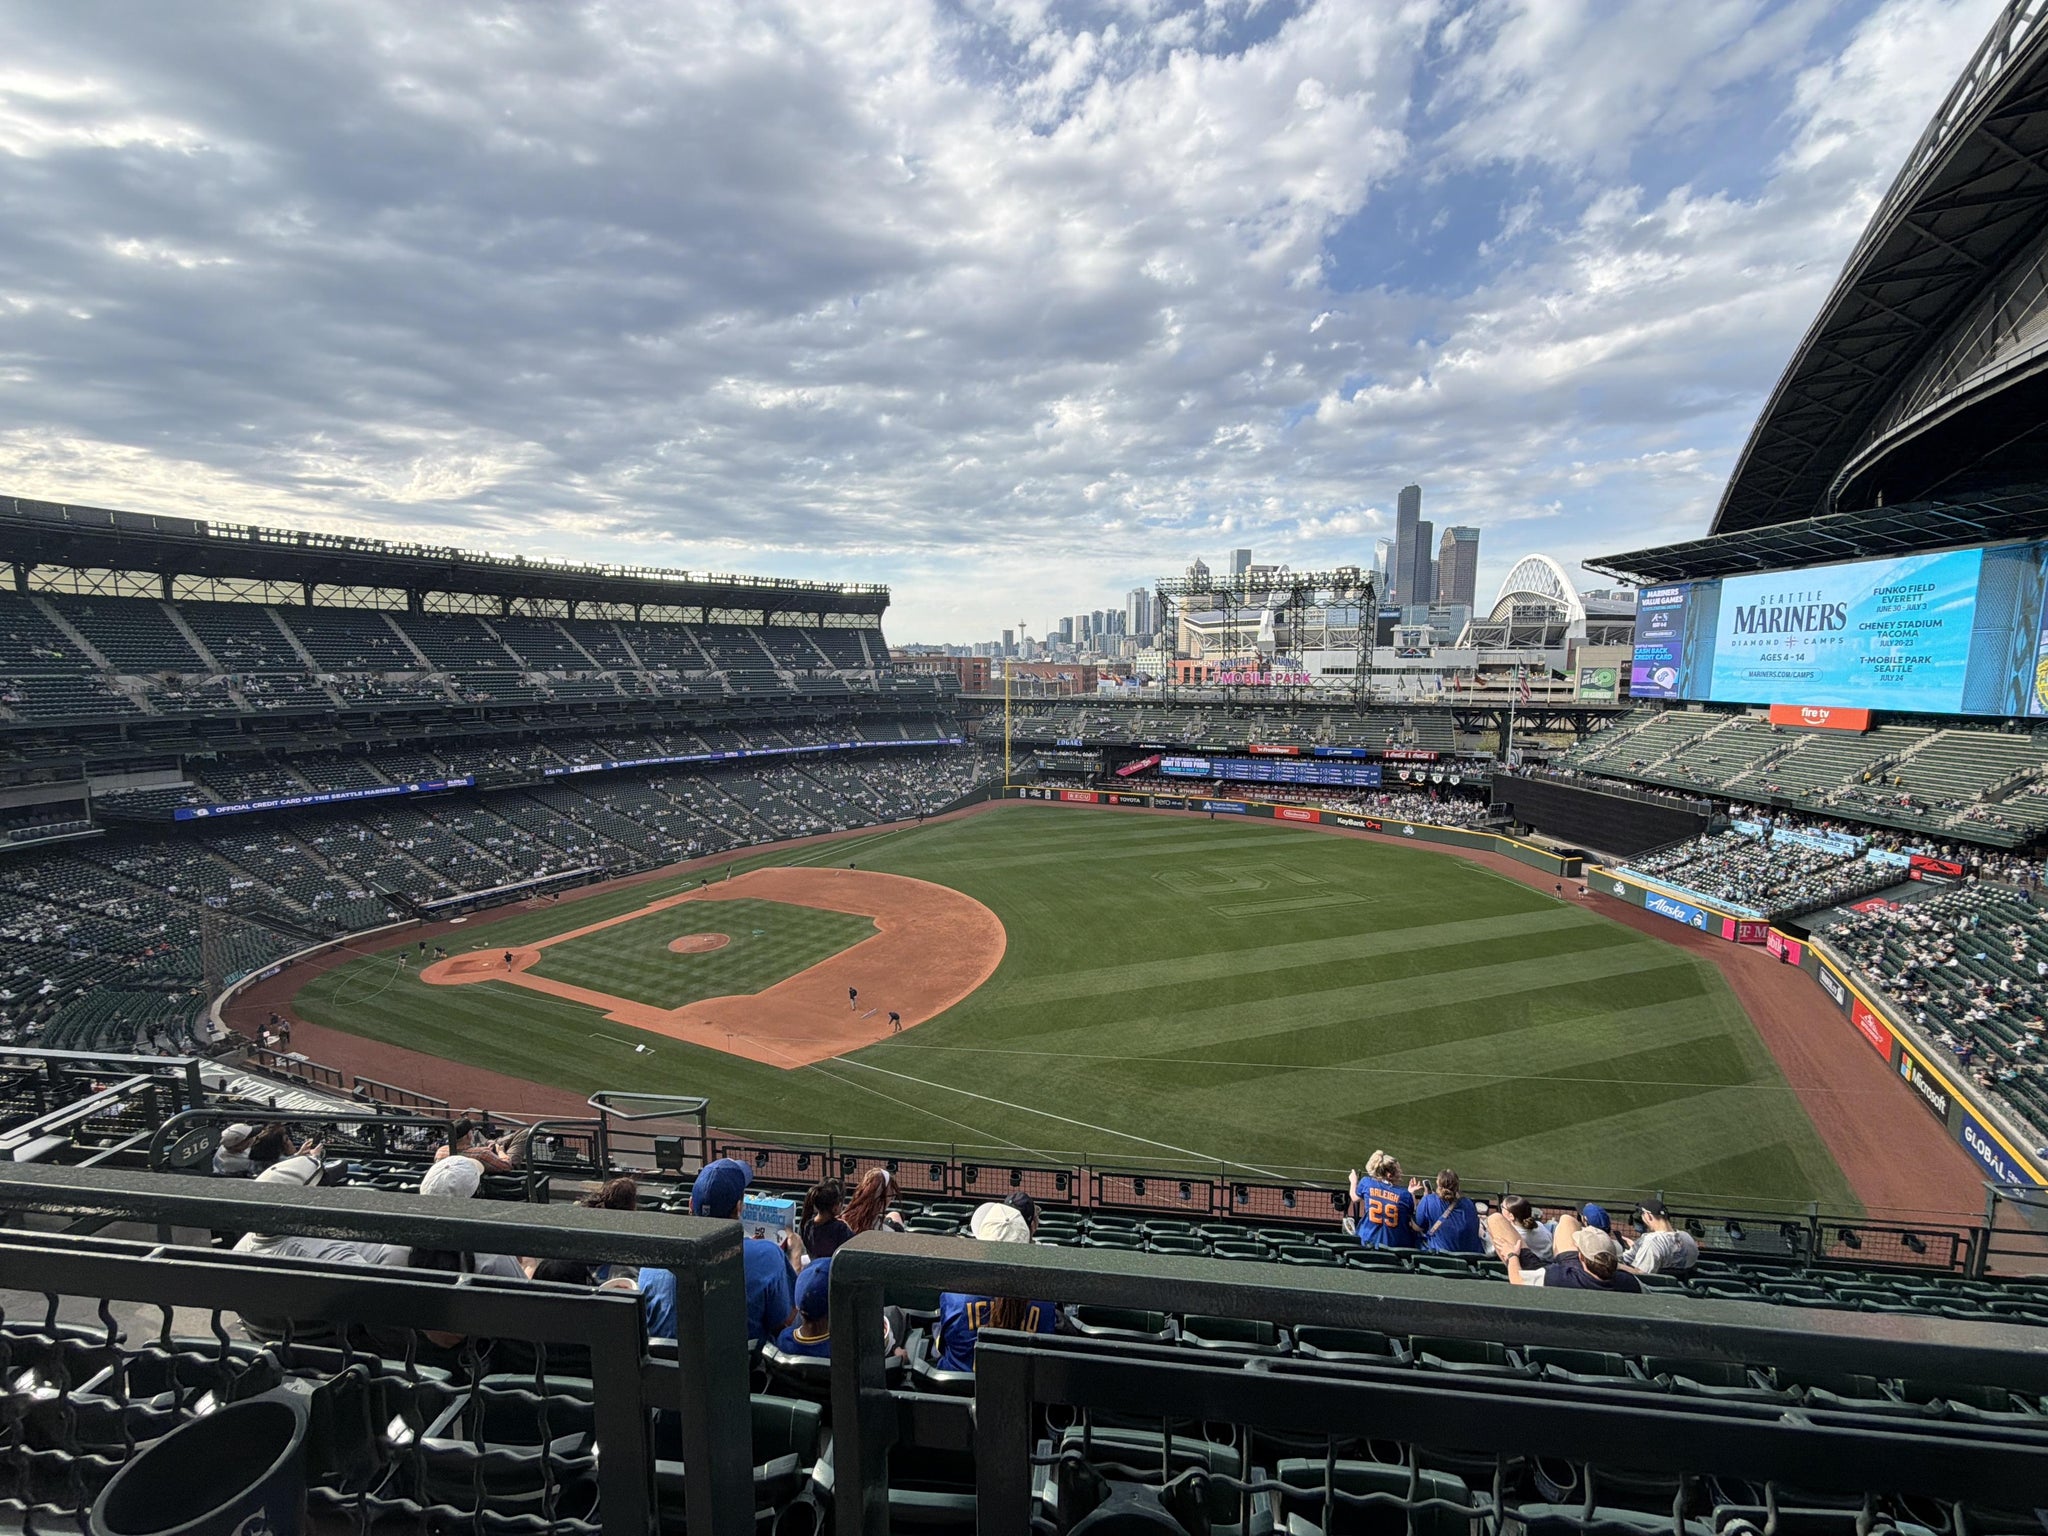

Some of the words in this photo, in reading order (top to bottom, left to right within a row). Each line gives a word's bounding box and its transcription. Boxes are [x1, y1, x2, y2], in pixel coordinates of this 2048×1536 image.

[1647, 588, 1679, 598] MARINERS
[1873, 586, 1907, 596] FUNKO
[1908, 584, 1936, 592] FIELD
[1661, 596, 1683, 604] GAMES
[1760, 590, 1822, 605] SEATTLE
[1882, 594, 1924, 604] EVERETT
[1733, 602, 1847, 634] MARINERS
[1859, 622, 1896, 630] CHENEY
[1896, 620, 1942, 628] STADIUM
[1804, 637, 1844, 645] CAMPS
[1877, 630, 1918, 638] TACOMA
[1220, 657, 1251, 670] SEATTLE
[1270, 655, 1302, 669] MARINERS
[1275, 672, 1312, 684] PARK
[1801, 707, 1818, 717] fire
[1820, 708, 1830, 717] tv
[216, 804, 250, 813] OFFICIAL
[252, 800, 278, 809] CREDIT
[331, 791, 363, 799] SEATTLE
[364, 787, 400, 796] MARINERS
[1337, 814, 1366, 828] KeyBank
[1813, 838, 1840, 847] SQUAD
[1648, 898, 1686, 920] Alaska
[1912, 1068, 1946, 1114] Microsoft
[182, 1138, 209, 1159] 316
[1965, 1126, 2006, 1180] GLOBAL
[1370, 1187, 1399, 1203] RALEIGH
[1369, 1198, 1399, 1228] 29
